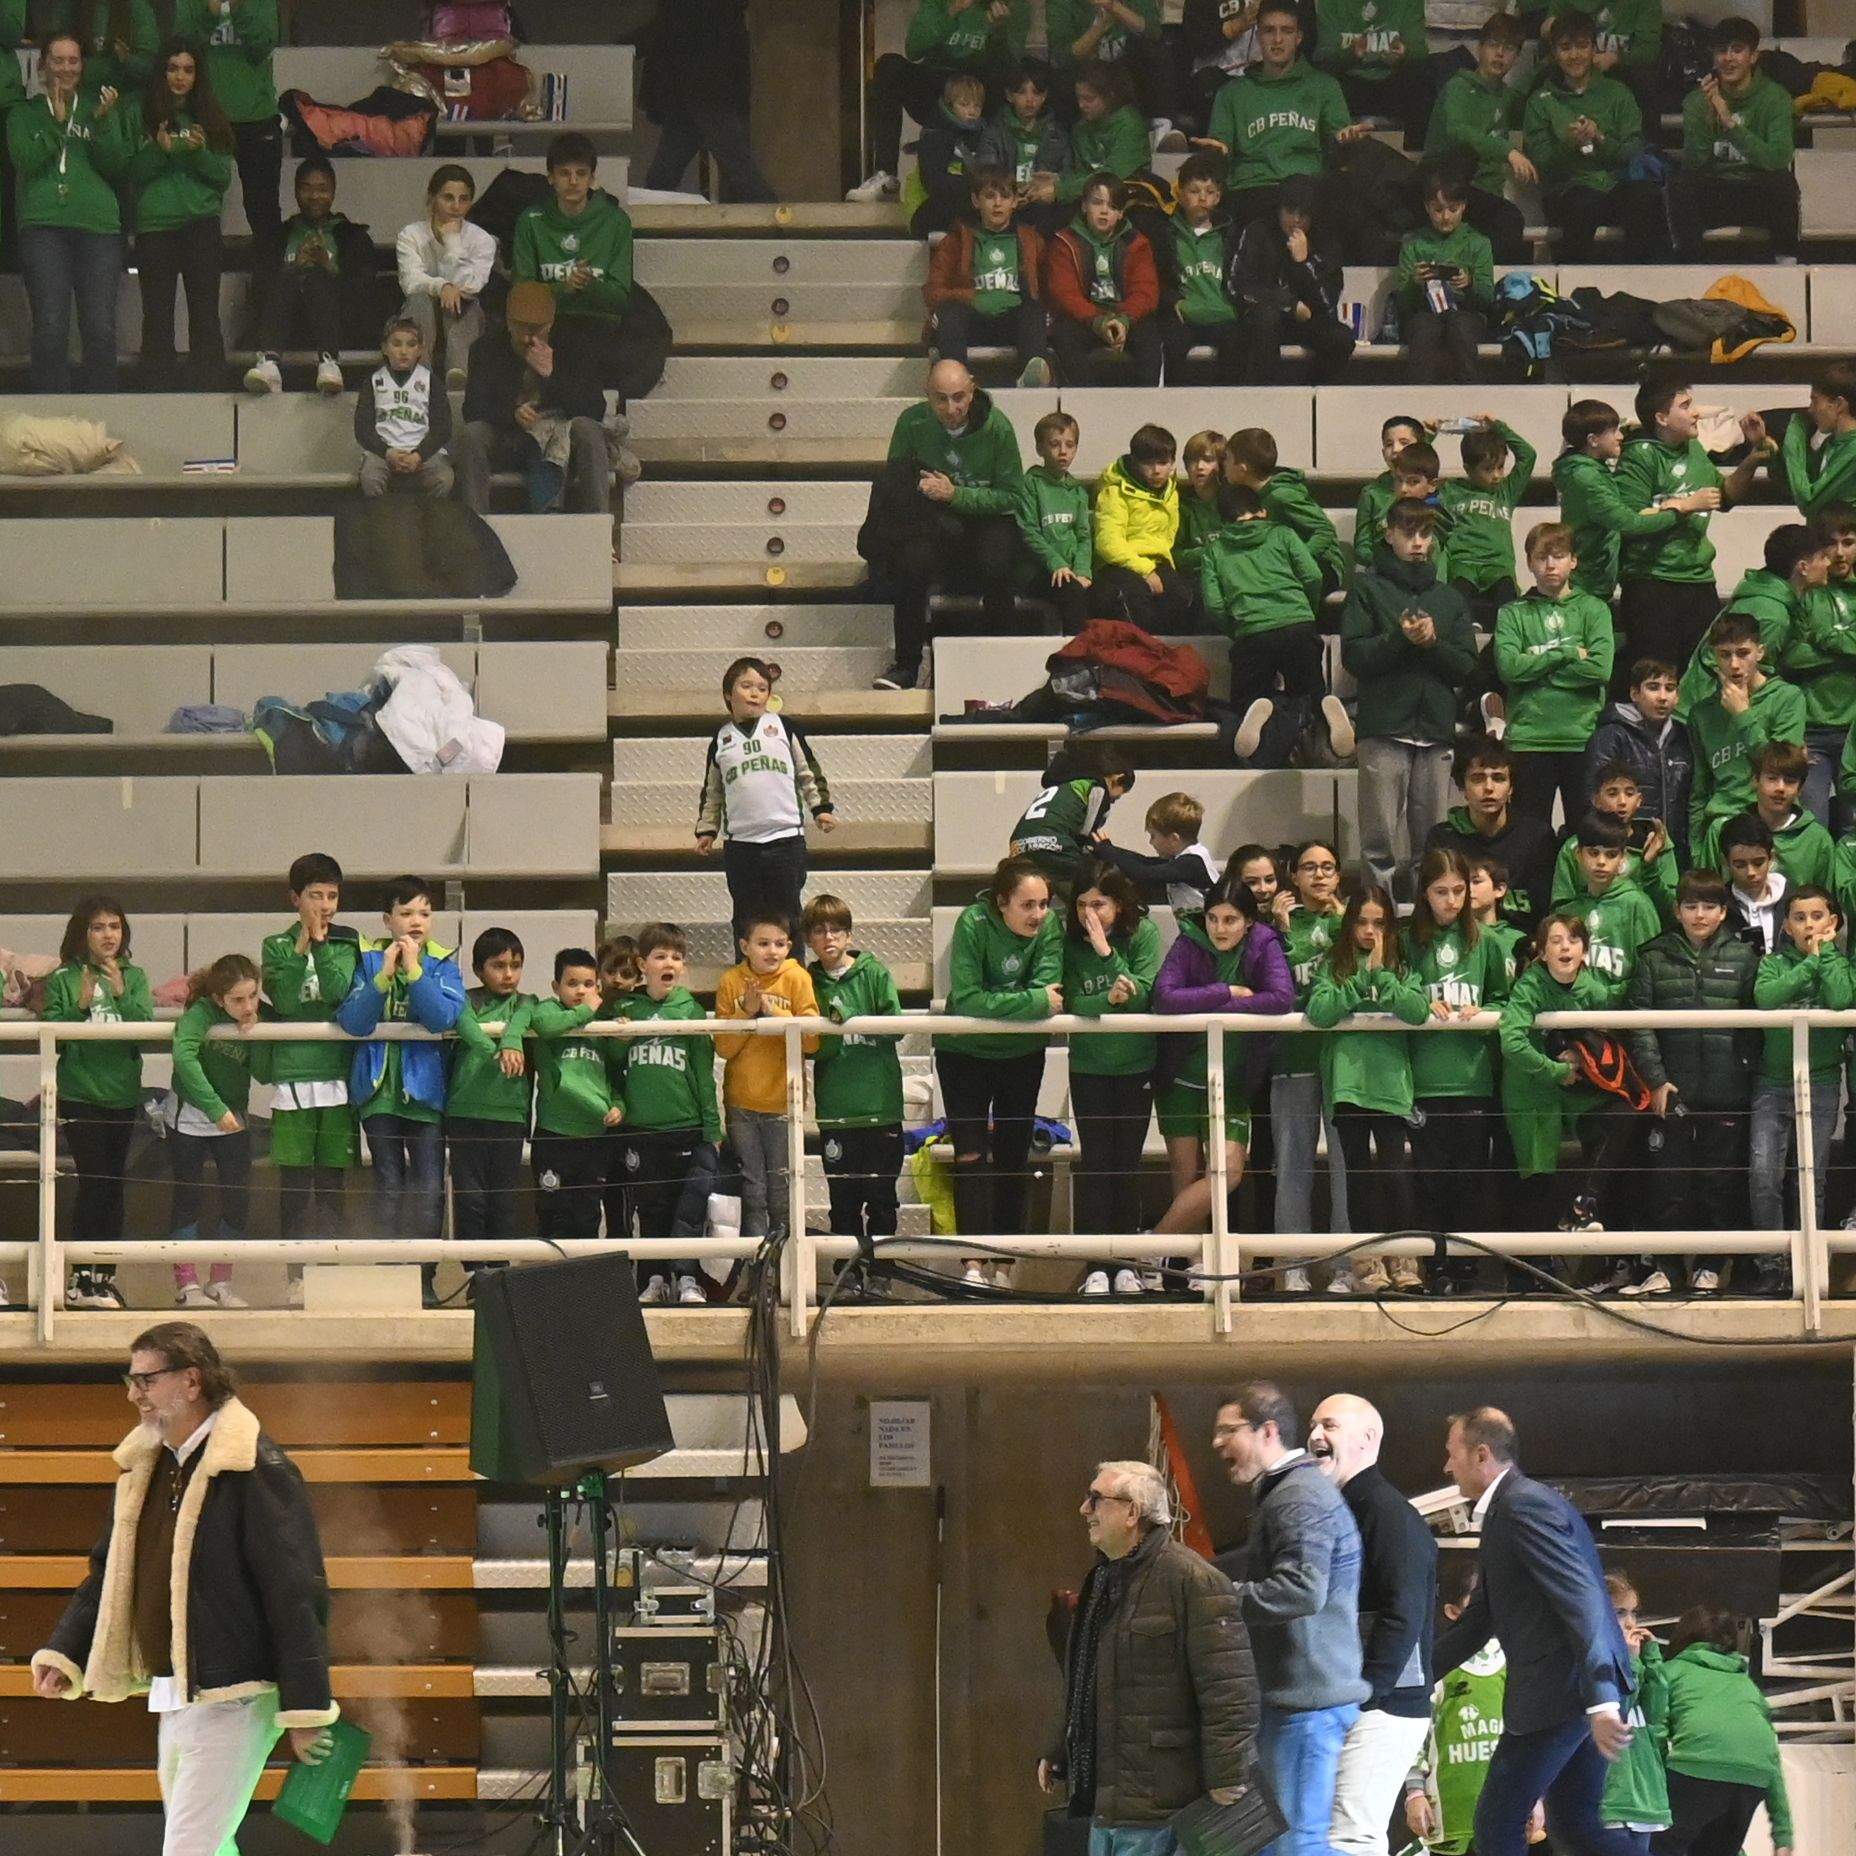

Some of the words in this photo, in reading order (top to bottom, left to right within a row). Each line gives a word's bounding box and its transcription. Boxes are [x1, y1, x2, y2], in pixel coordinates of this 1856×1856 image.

[1269, 111, 1316, 132] PEÑAS
[393, 390, 409, 404] 96
[742, 739, 762, 756] 90
[1025, 786, 1059, 820] 2
